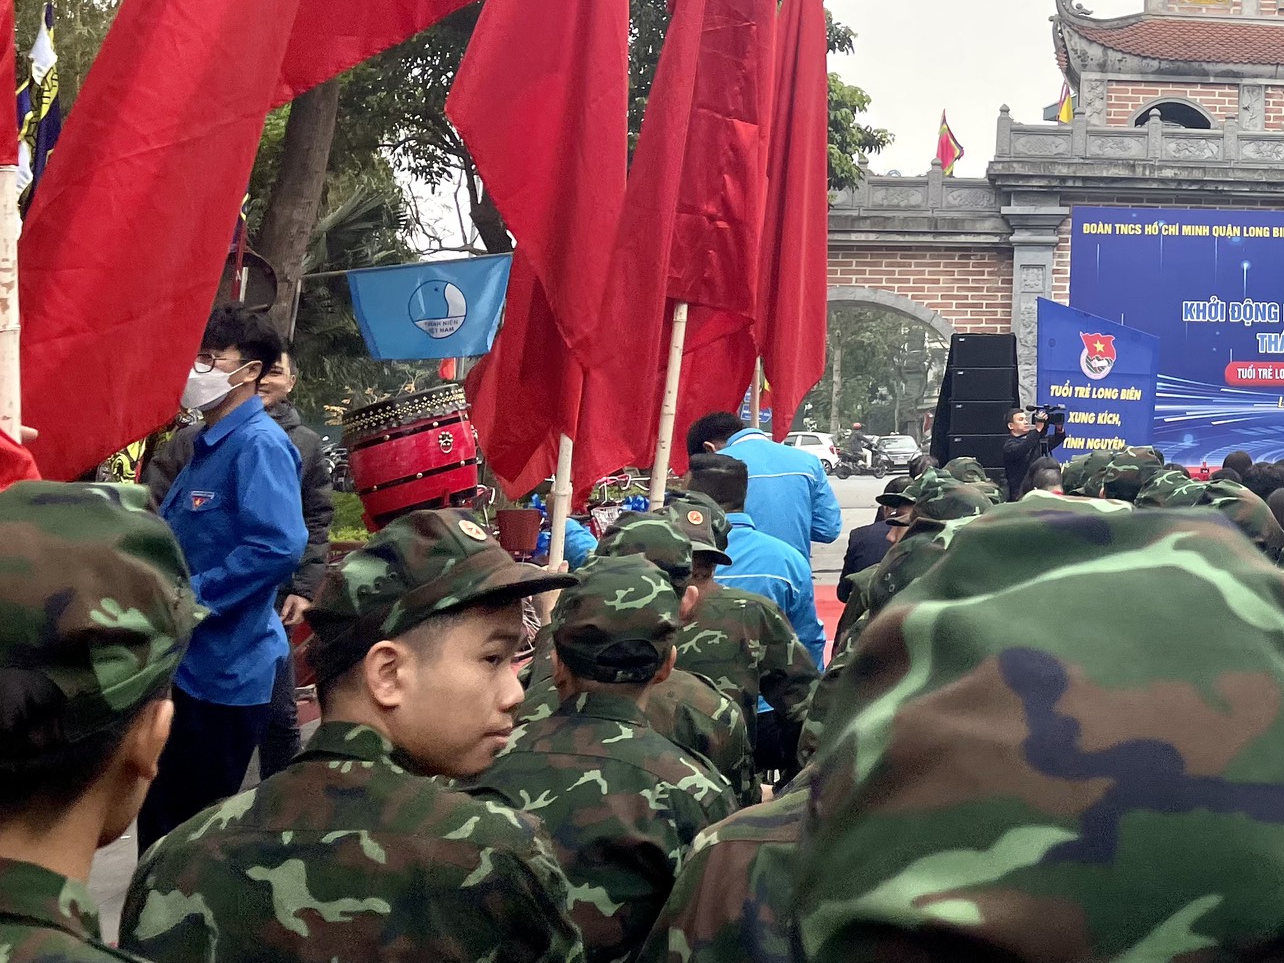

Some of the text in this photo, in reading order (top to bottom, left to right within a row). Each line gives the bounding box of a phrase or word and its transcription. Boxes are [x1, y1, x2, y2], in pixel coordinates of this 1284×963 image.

[1082, 221, 1111, 235] ĐOÀN
[1114, 224, 1142, 235] TNCS
[1144, 221, 1159, 236] HỒ
[1162, 222, 1179, 236] CHÍ
[1182, 225, 1210, 237] MINH
[1212, 223, 1240, 240] QUẬN
[1243, 226, 1270, 238] LONG
[1182, 296, 1226, 323] KHỞI
[1229, 299, 1279, 326] ĐỘNG
[1236, 365, 1256, 380] TUỔI
[1258, 364, 1273, 380] TRẺ
[1050, 380, 1142, 401] TUỔI TRẺ LONG BIÊN
[1067, 410, 1122, 426] XUNG KÍCH,
